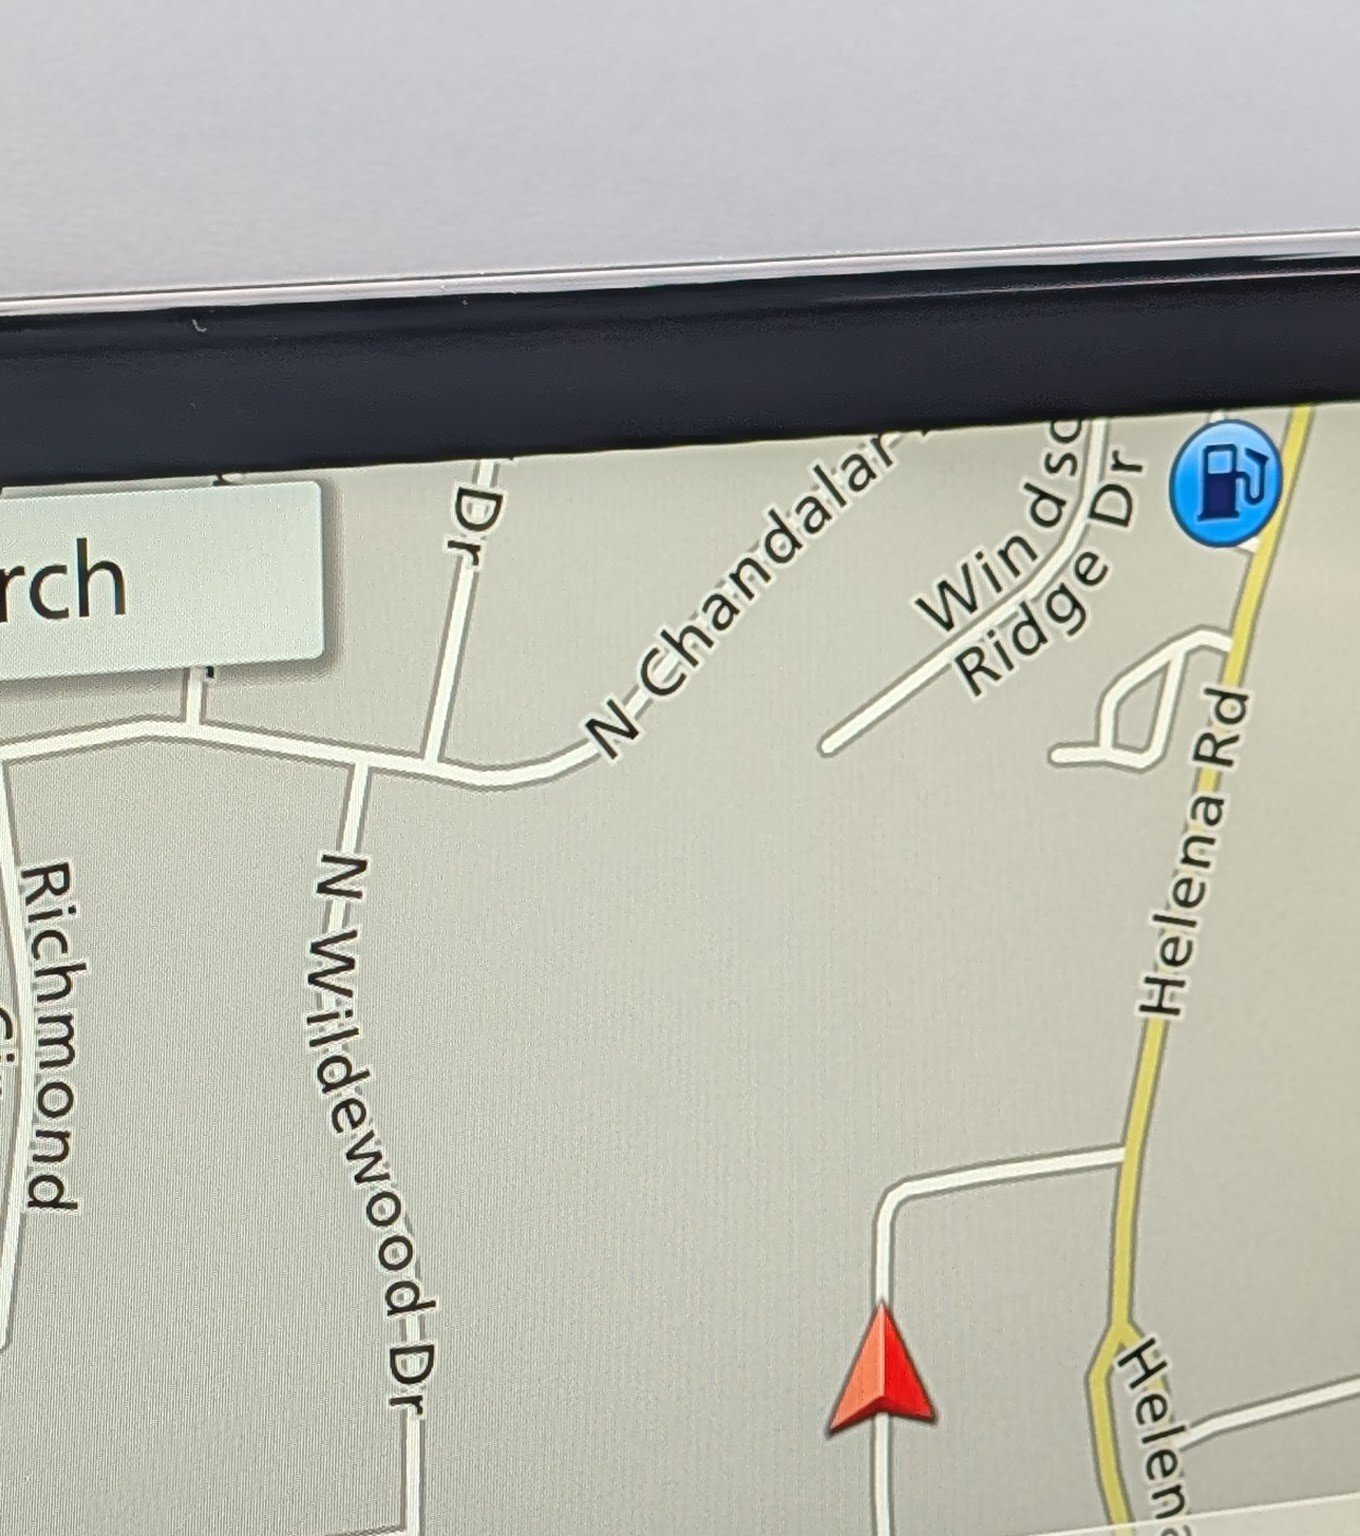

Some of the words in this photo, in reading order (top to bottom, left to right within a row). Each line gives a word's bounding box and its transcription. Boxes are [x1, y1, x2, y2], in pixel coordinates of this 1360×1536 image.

[447, 487, 504, 567] Dr
[954, 550, 1109, 695] Ridge
[1088, 449, 1144, 528] Dr
[585, 698, 640, 760] N
[316, 853, 368, 899] N
[1139, 792, 1224, 1017] Helena
[1192, 687, 1252, 768] Rd
[21, 862, 87, 1211] Richmond
[306, 929, 437, 1316] Wildewood
[388, 1343, 435, 1416] Dr
